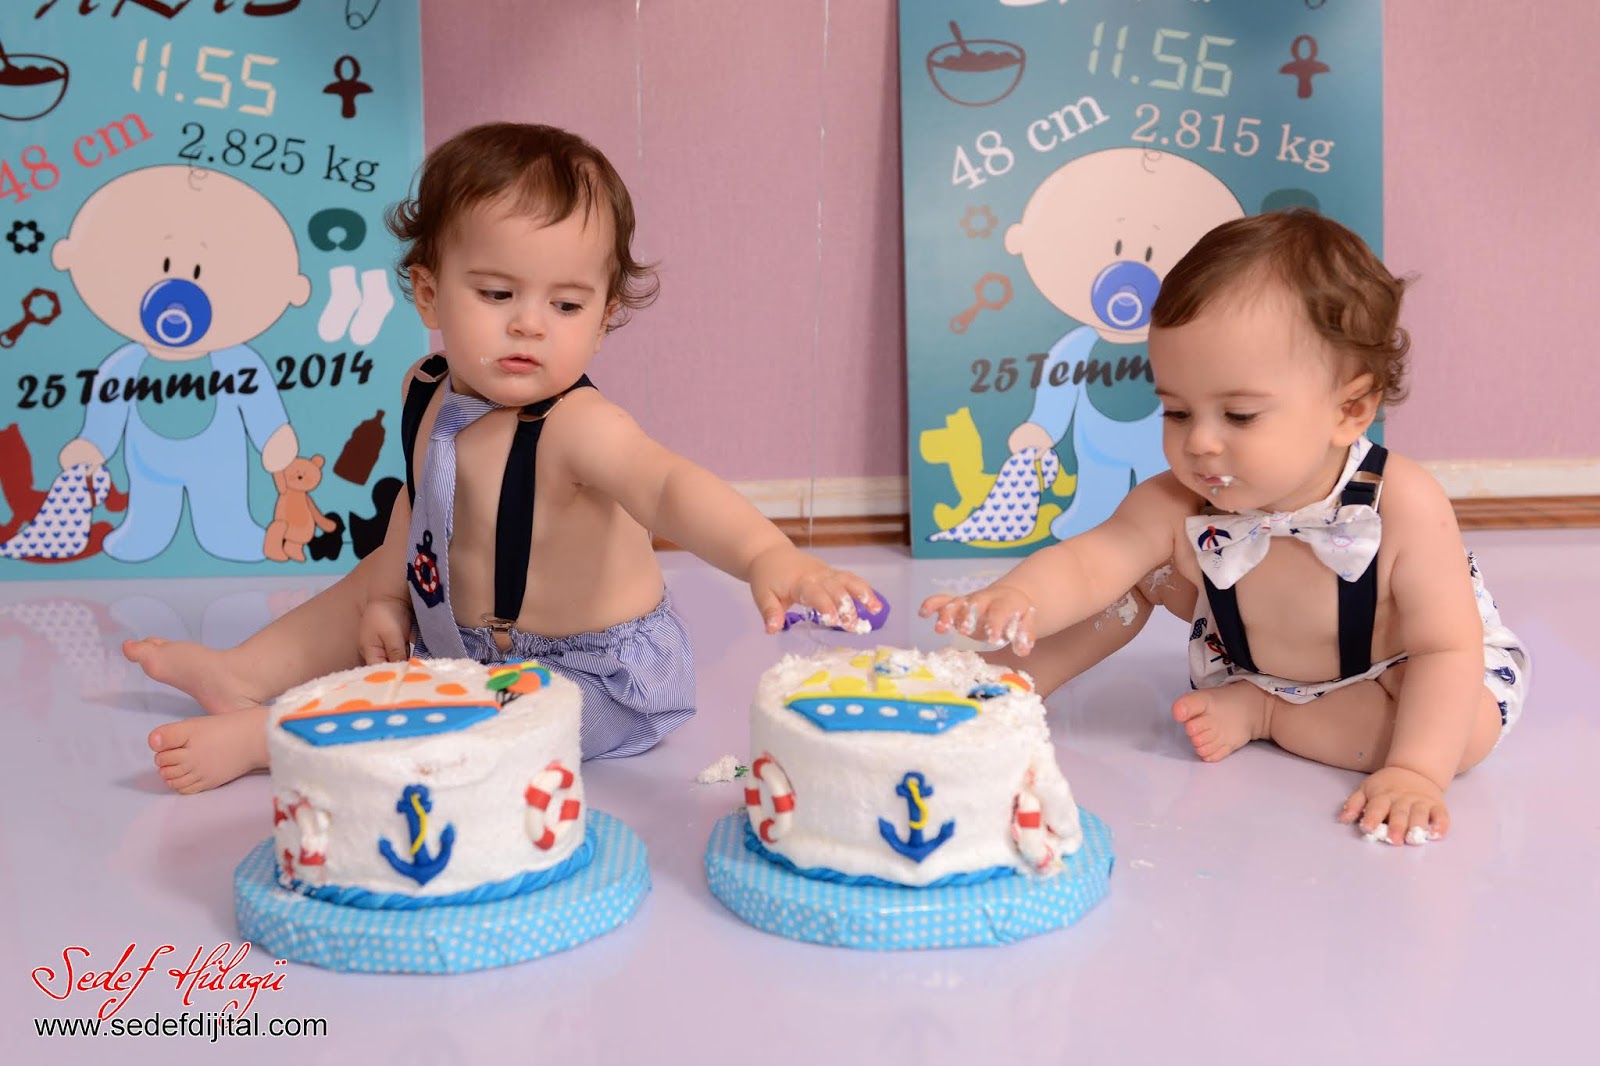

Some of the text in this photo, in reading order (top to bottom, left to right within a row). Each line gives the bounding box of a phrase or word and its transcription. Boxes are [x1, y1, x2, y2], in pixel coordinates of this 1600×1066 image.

[131, 37, 280, 117] 11.55
[1087, 21, 1237, 97] 11.56
[0, 112, 154, 204] 48 cm
[177, 122, 380, 193] 2.825 kg
[950, 95, 1110, 191] 48 cm
[1130, 103, 1335, 173] 2.815 kg
[17, 350, 374, 409] 25 Temmuz 2014
[969, 352, 1156, 394] 25 Temm
